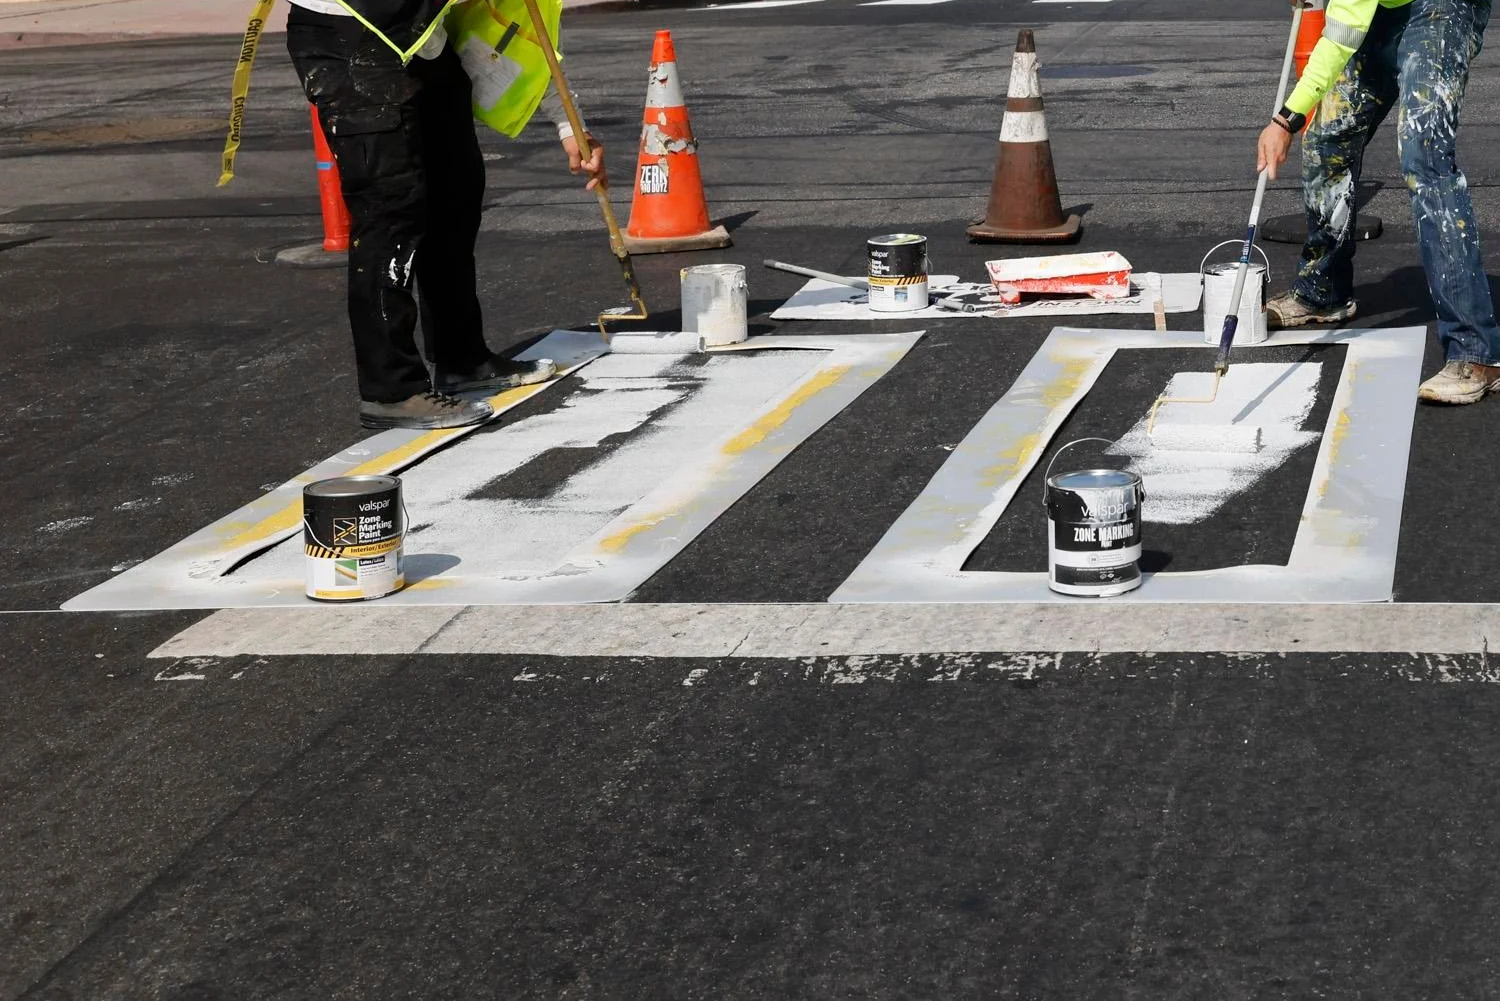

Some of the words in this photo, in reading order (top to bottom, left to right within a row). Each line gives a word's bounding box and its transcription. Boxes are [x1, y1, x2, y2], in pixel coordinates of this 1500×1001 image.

[359, 499, 391, 512] valspar
[359, 515, 381, 524] Zone
[359, 520, 392, 532] Marking
[359, 529, 381, 540] Paint
[1074, 527, 1096, 542] ZONE
[1099, 523, 1134, 541] MARKING
